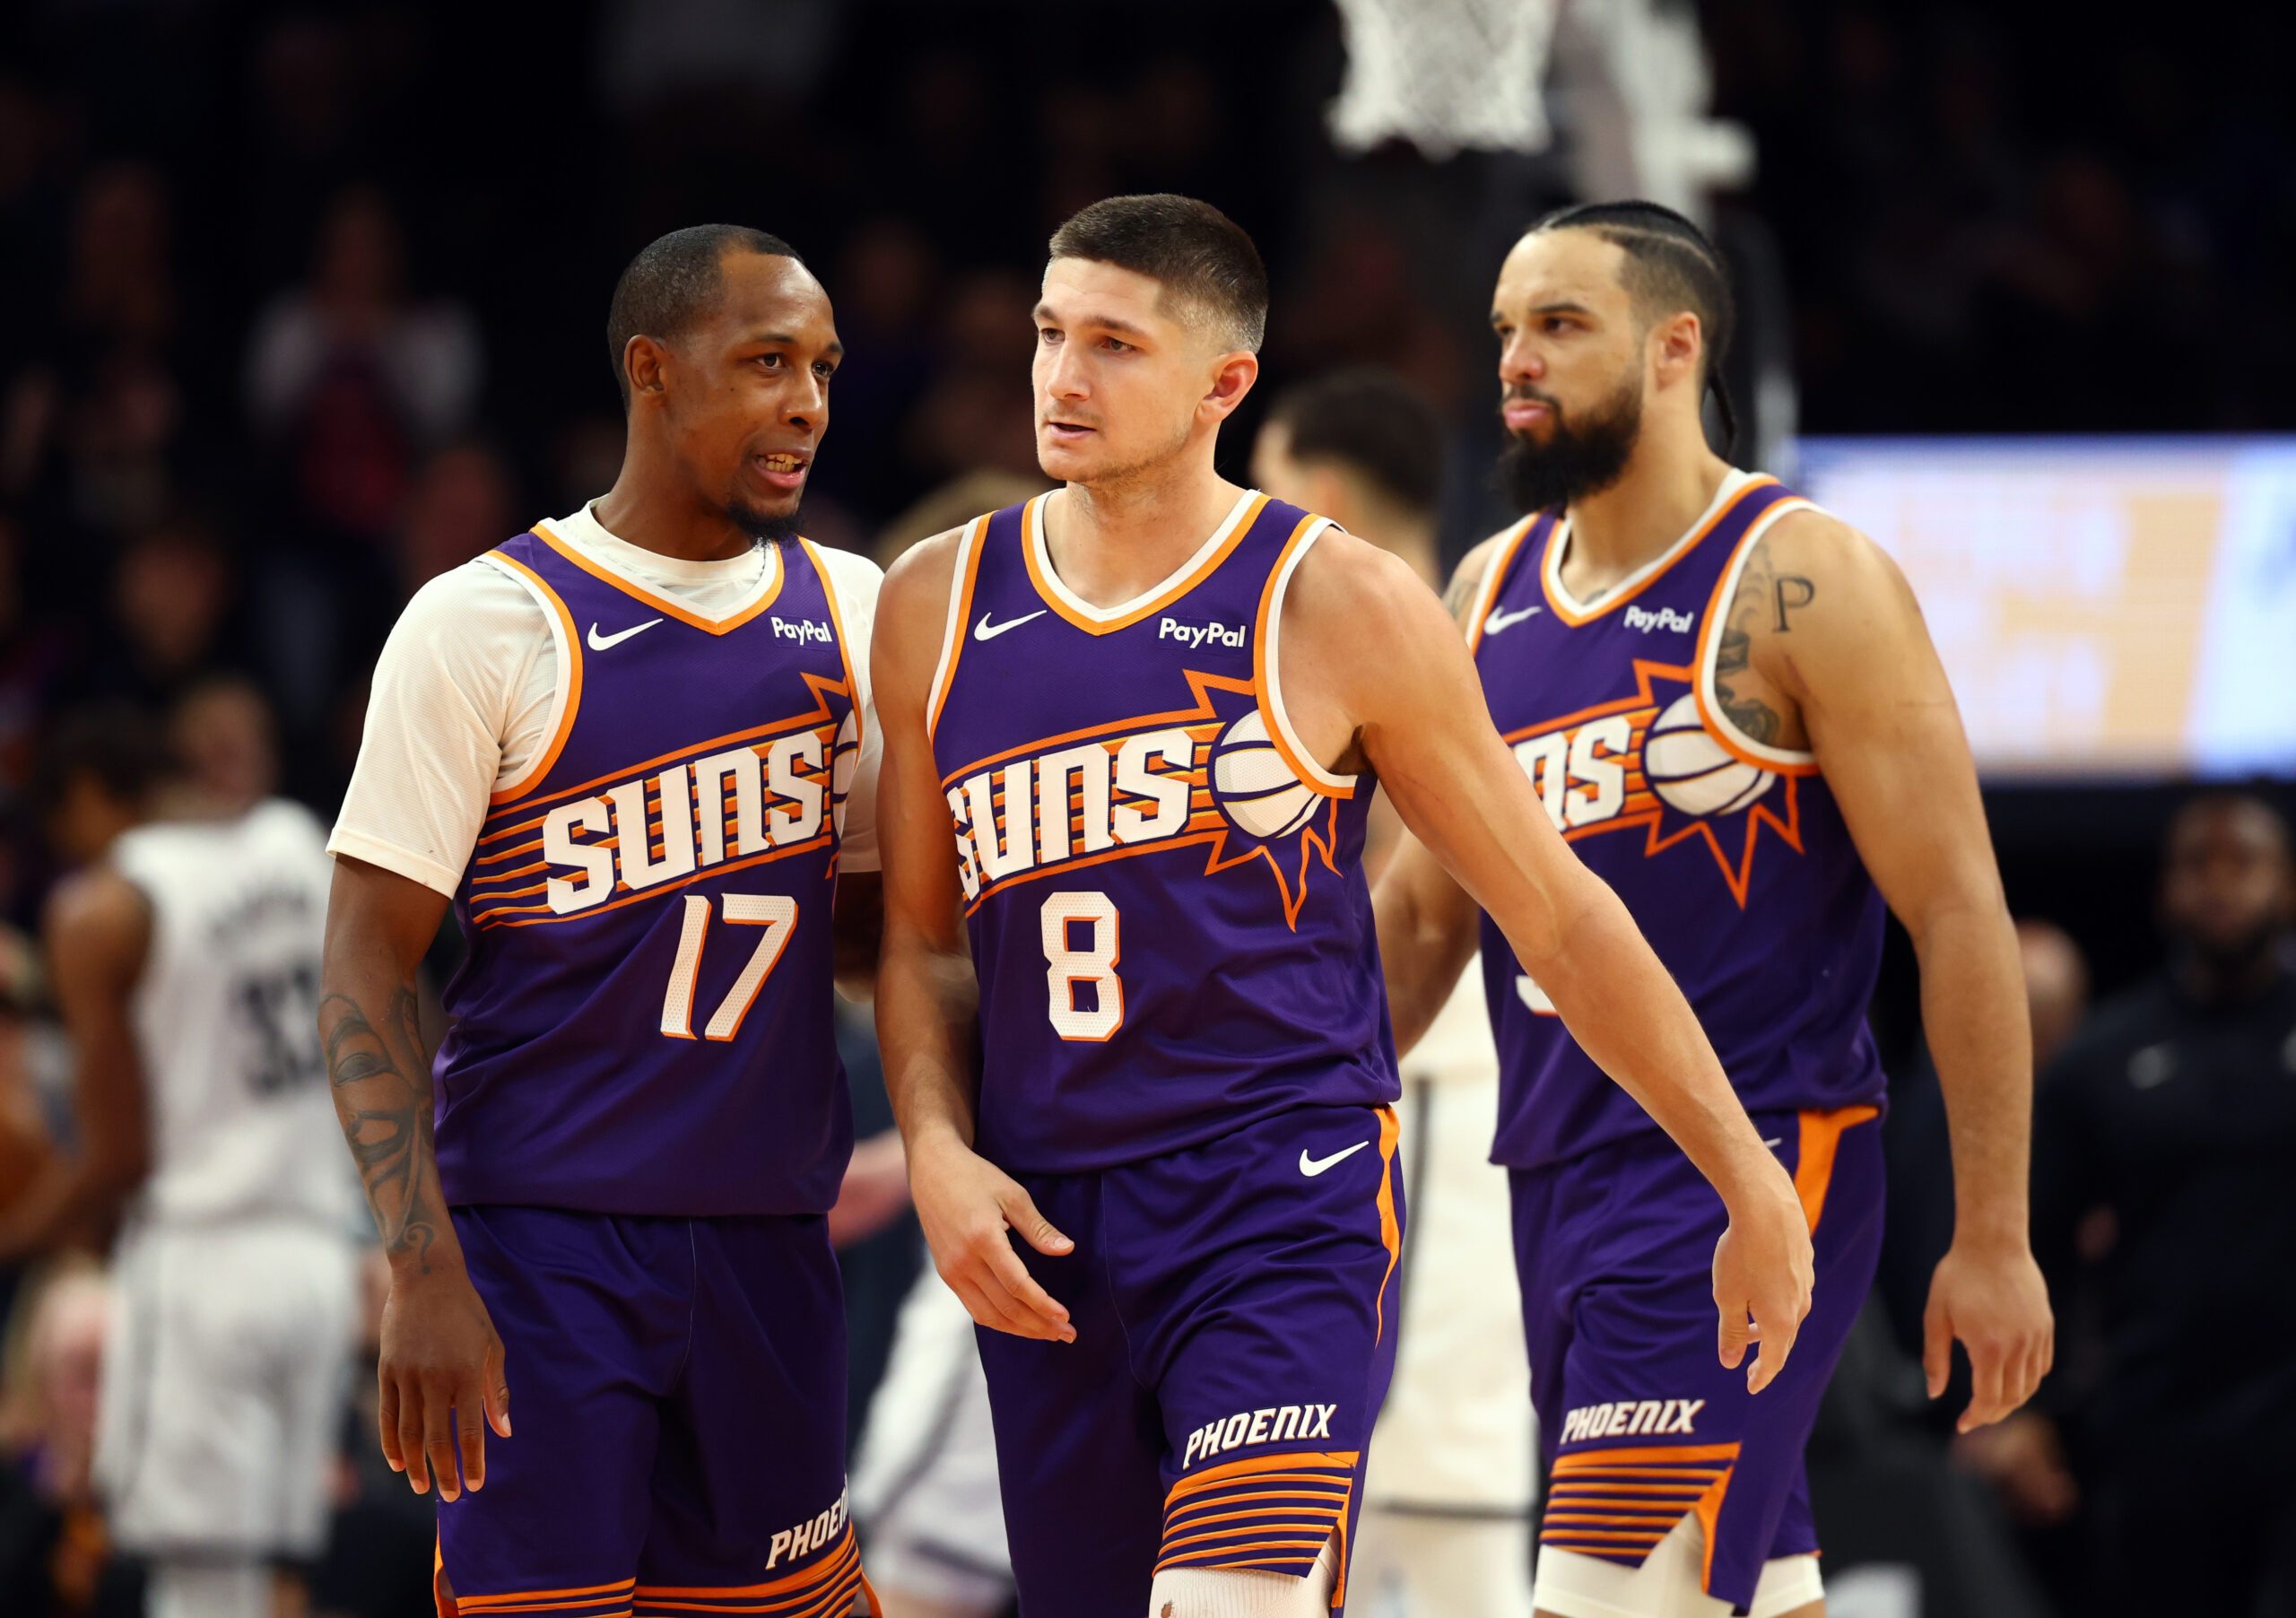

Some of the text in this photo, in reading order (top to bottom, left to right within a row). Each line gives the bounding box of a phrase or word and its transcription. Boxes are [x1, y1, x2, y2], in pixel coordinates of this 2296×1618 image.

[770, 616, 833, 646] PayPal
[1159, 617, 1246, 648] PayPal
[1623, 605, 1694, 634] PayPal
[1773, 576, 1816, 633] P
[1514, 716, 1632, 832] NS
[542, 730, 825, 916] SUNS
[660, 892, 799, 1042] 17
[1039, 891, 1125, 1041] 8
[1182, 1403, 1337, 1471] PHOENIX
[1560, 1398, 1706, 1446] PHOENIX
[765, 1472, 849, 1570] PHOEN
